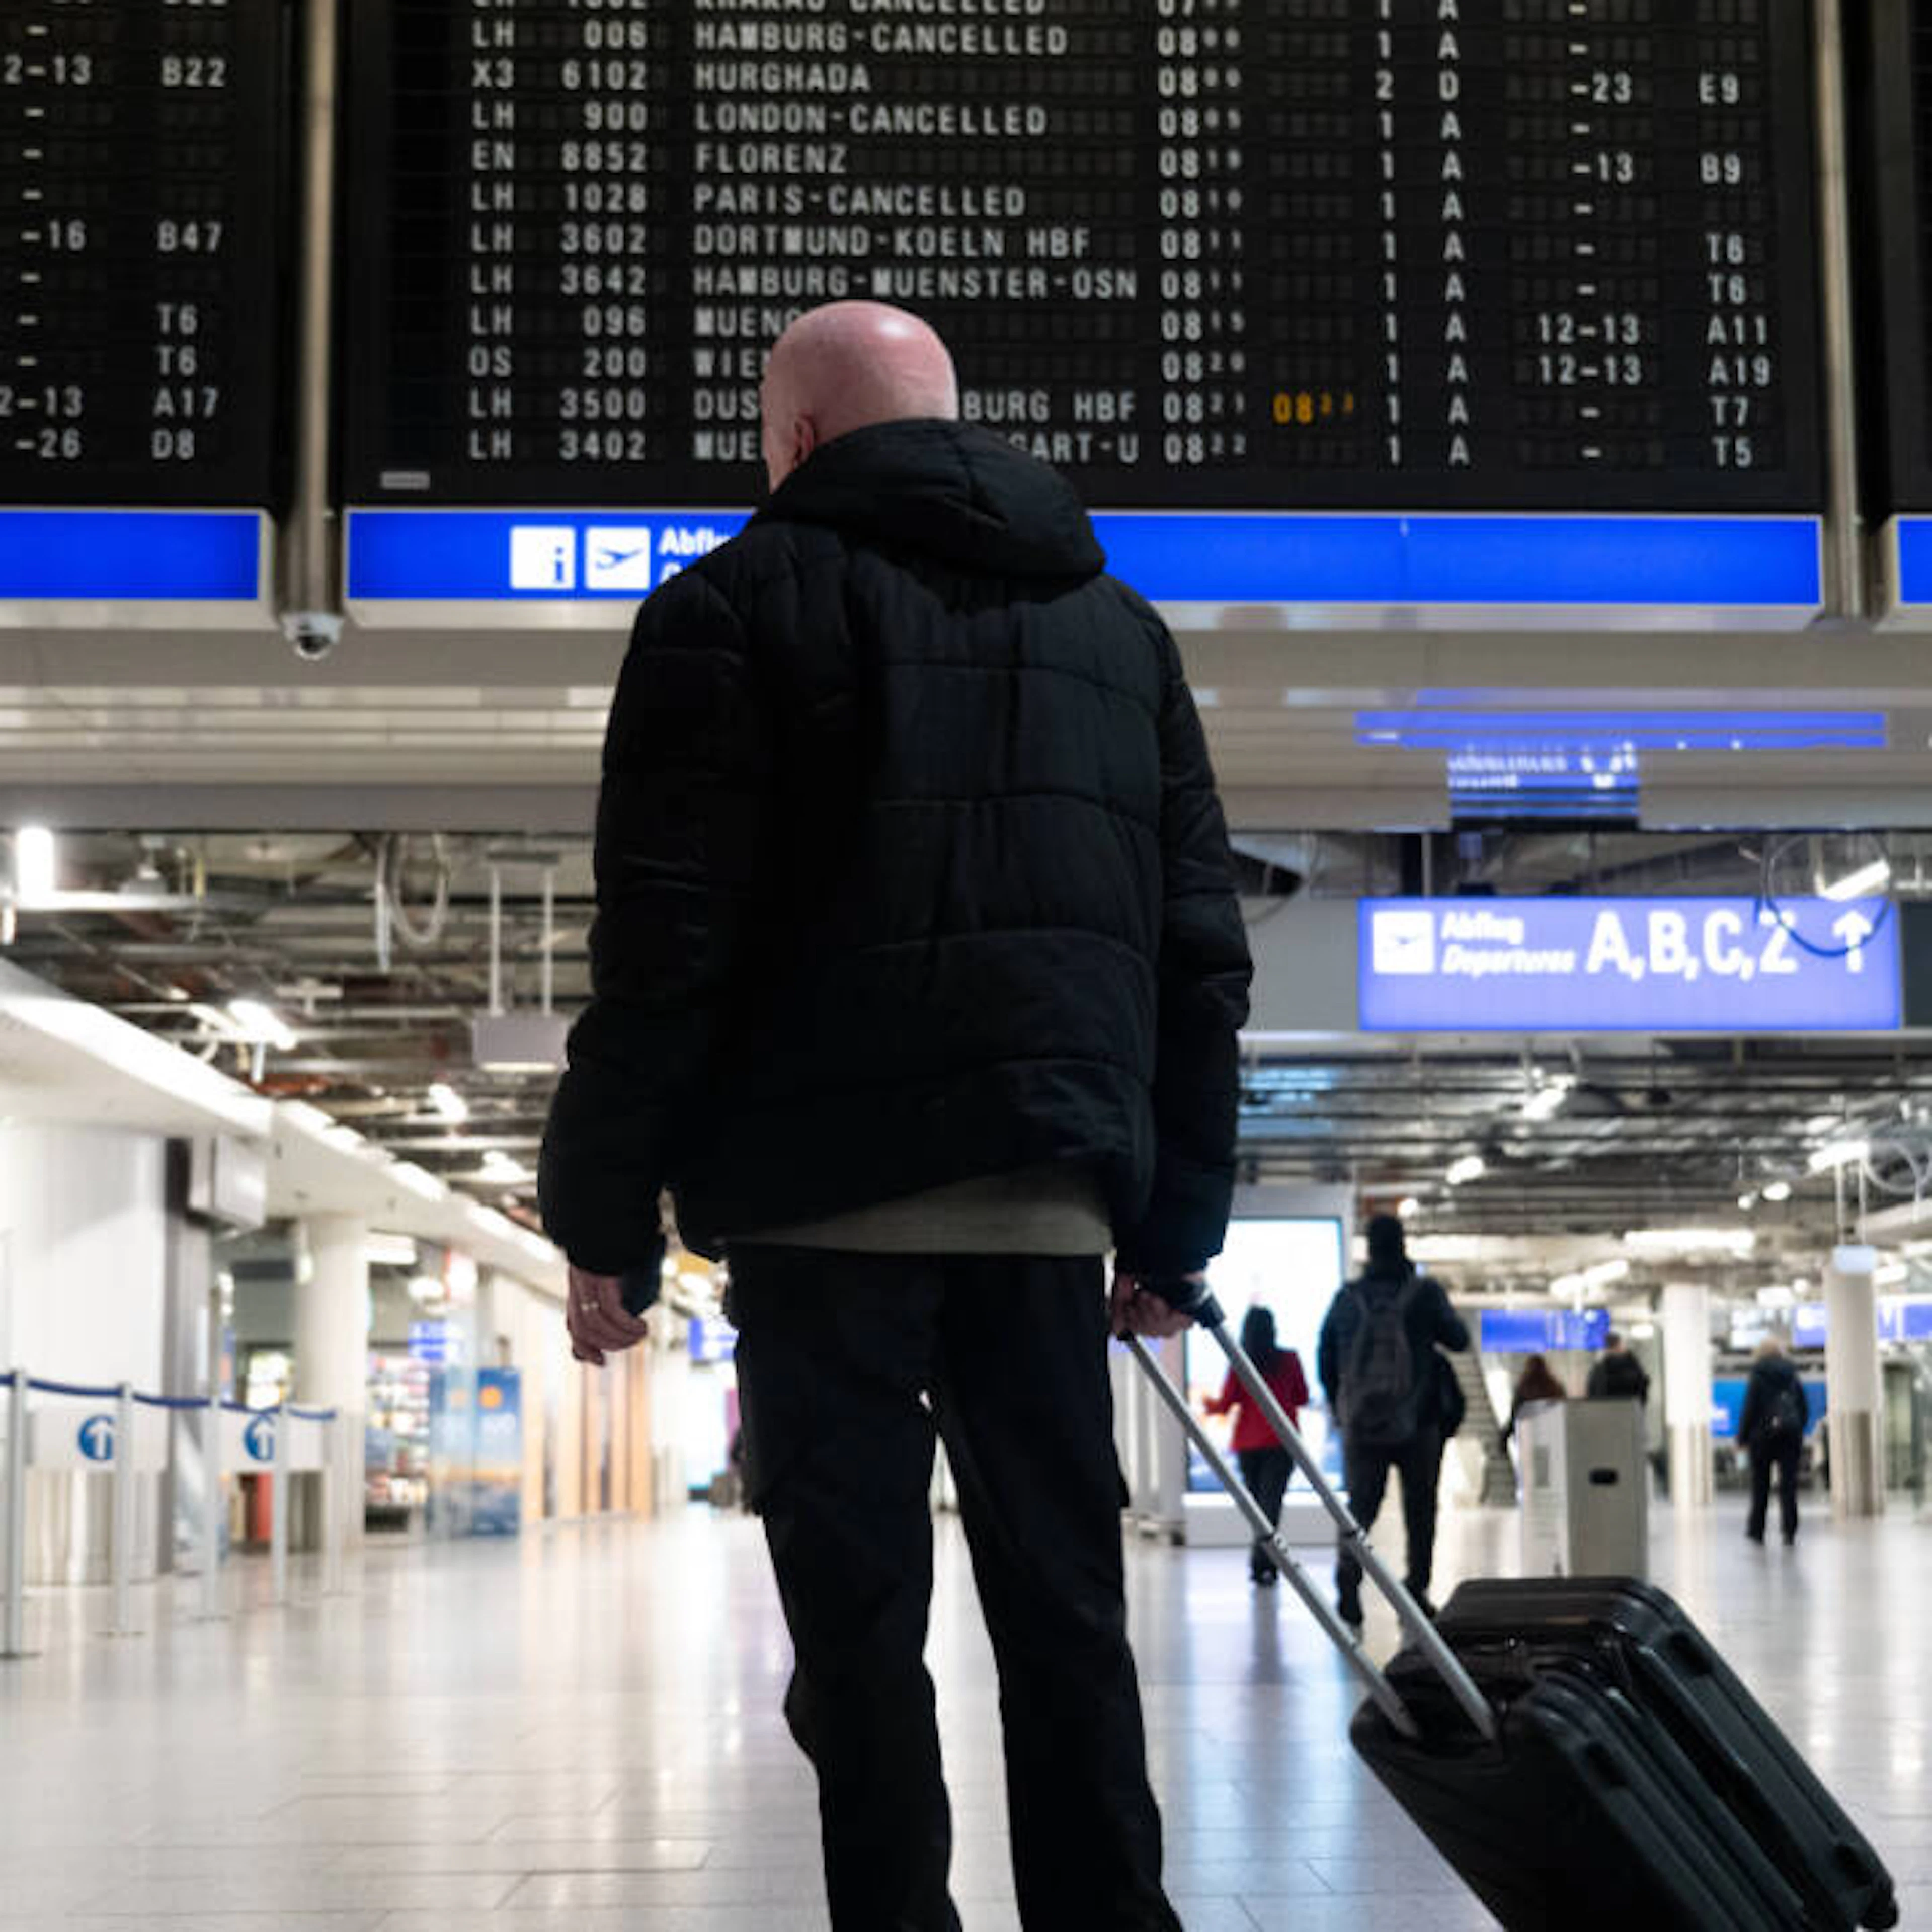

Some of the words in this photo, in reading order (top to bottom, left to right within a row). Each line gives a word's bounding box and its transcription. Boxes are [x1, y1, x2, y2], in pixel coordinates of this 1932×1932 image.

[473, 20, 515, 48] LH
[1378, 32, 1391, 58] 1
[1438, 32, 1458, 58] A
[162, 57, 225, 87] B22
[472, 59, 514, 89] X3
[562, 61, 646, 90] 6102
[696, 63, 869, 92] HURGHADA
[1376, 71, 1393, 99] 2
[1700, 75, 1739, 104] E9
[473, 102, 514, 129] LH
[584, 102, 646, 130] 900
[1380, 112, 1392, 138] 1
[1441, 112, 1461, 138] A
[472, 141, 514, 170] EN
[562, 143, 646, 172] 8852
[696, 145, 845, 173] FLORENZ
[1381, 152, 1394, 178] 1
[1442, 152, 1462, 179] A
[1701, 154, 1741, 184] B9
[472, 184, 514, 211] LH
[565, 184, 646, 212] 1028
[1382, 193, 1395, 219] 1
[1443, 193, 1462, 219] A
[158, 222, 221, 251] B47
[472, 225, 513, 252] LH
[561, 224, 645, 253] 3602
[1029, 228, 1089, 257] HBF
[1383, 232, 1396, 259] 1
[1444, 233, 1464, 259] A
[471, 267, 512, 293] LH
[561, 266, 645, 294] 3642
[1384, 273, 1396, 300] 1
[1445, 274, 1465, 301] A
[159, 304, 197, 334] T6
[471, 307, 512, 334] LH
[1385, 314, 1397, 341] 1
[1446, 314, 1466, 341] A
[1539, 313, 1639, 344] 12-13
[1707, 315, 1767, 345] A11
[158, 346, 196, 375] T6
[584, 348, 646, 377] 200
[1386, 354, 1398, 381] 1
[1448, 355, 1467, 382] A
[1540, 355, 1641, 385] 12-13
[1709, 356, 1770, 386] A19
[154, 387, 218, 417] A17
[470, 390, 511, 417] LH
[560, 389, 645, 418] 3500
[1074, 392, 1136, 421] HBF
[1387, 395, 1399, 423] 1
[1448, 396, 1468, 423] A
[1710, 396, 1749, 426] T7
[152, 430, 195, 459] D8
[470, 432, 511, 459] LH
[560, 431, 645, 460] 3402
[695, 432, 761, 460] MUE
[1388, 436, 1400, 463] 1
[1450, 436, 1469, 463] A
[1712, 436, 1752, 467] T5
